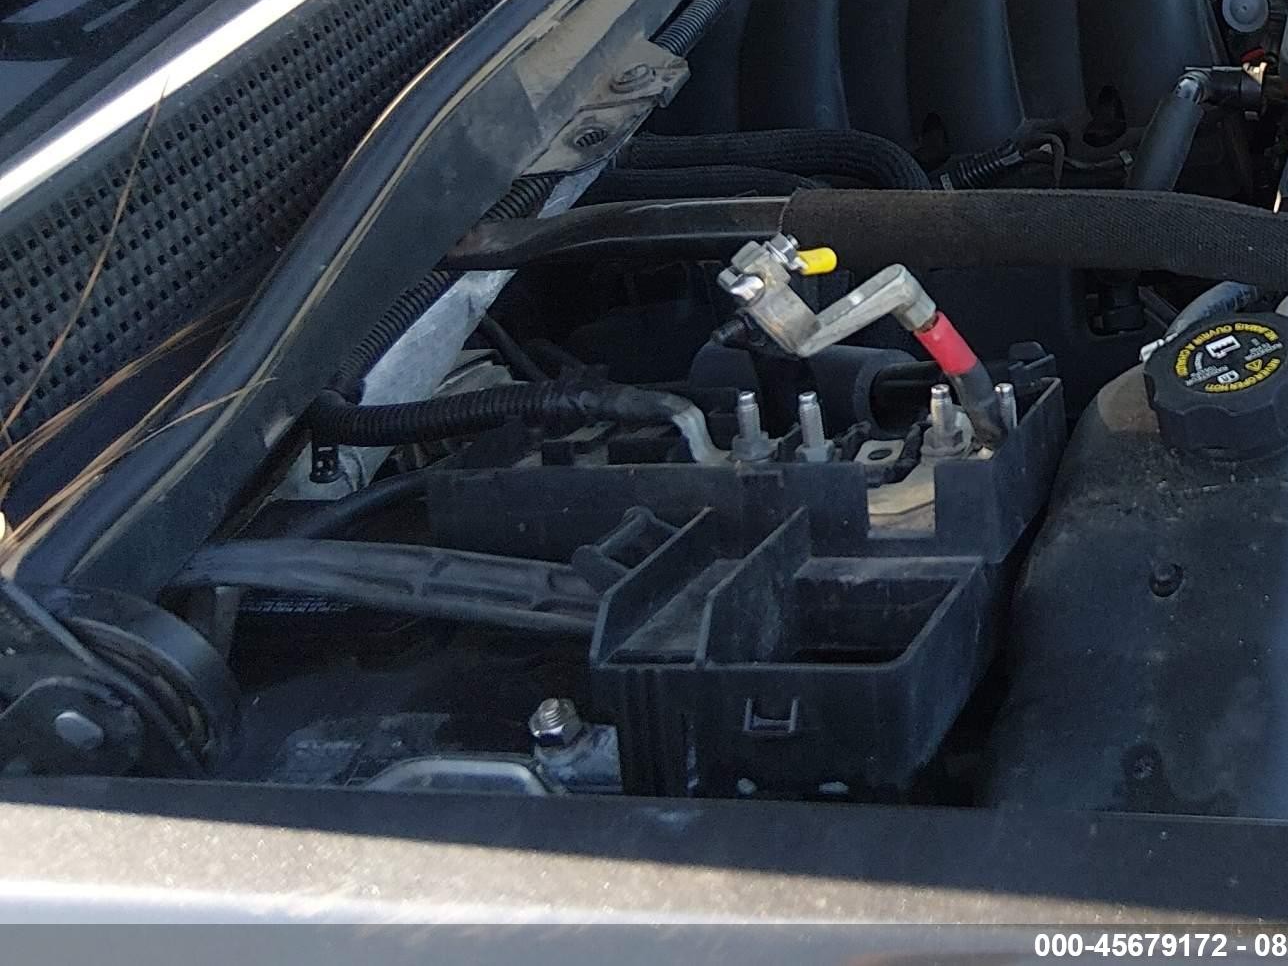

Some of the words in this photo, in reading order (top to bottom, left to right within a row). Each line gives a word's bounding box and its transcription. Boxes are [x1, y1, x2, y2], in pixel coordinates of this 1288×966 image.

[1192, 325, 1232, 345] OUVRIR
[1256, 358, 1280, 381] NEVER
[1230, 377, 1256, 390] OPEN
